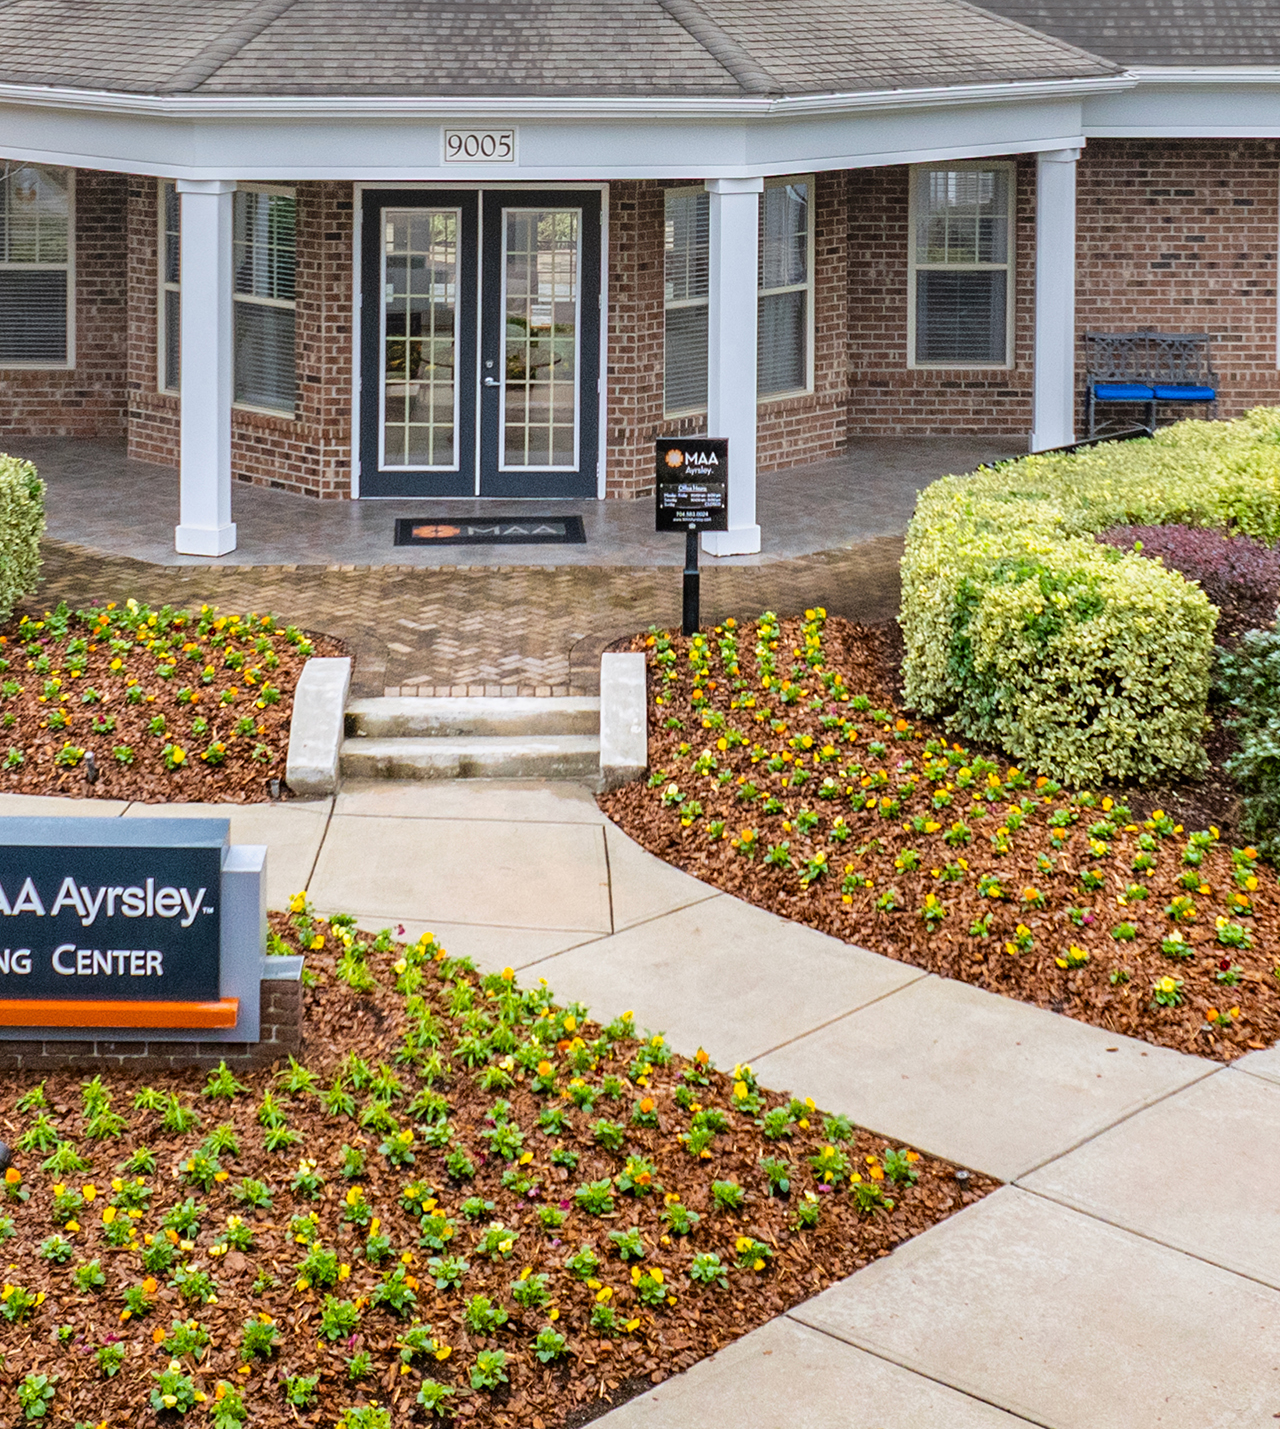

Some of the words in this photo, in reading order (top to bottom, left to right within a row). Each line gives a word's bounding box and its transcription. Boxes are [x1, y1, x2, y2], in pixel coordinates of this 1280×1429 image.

[447, 134, 511, 158] 9005
[685, 452, 718, 465] MAA
[467, 525, 557, 535] MAA
[52, 943, 163, 977] CENTER
